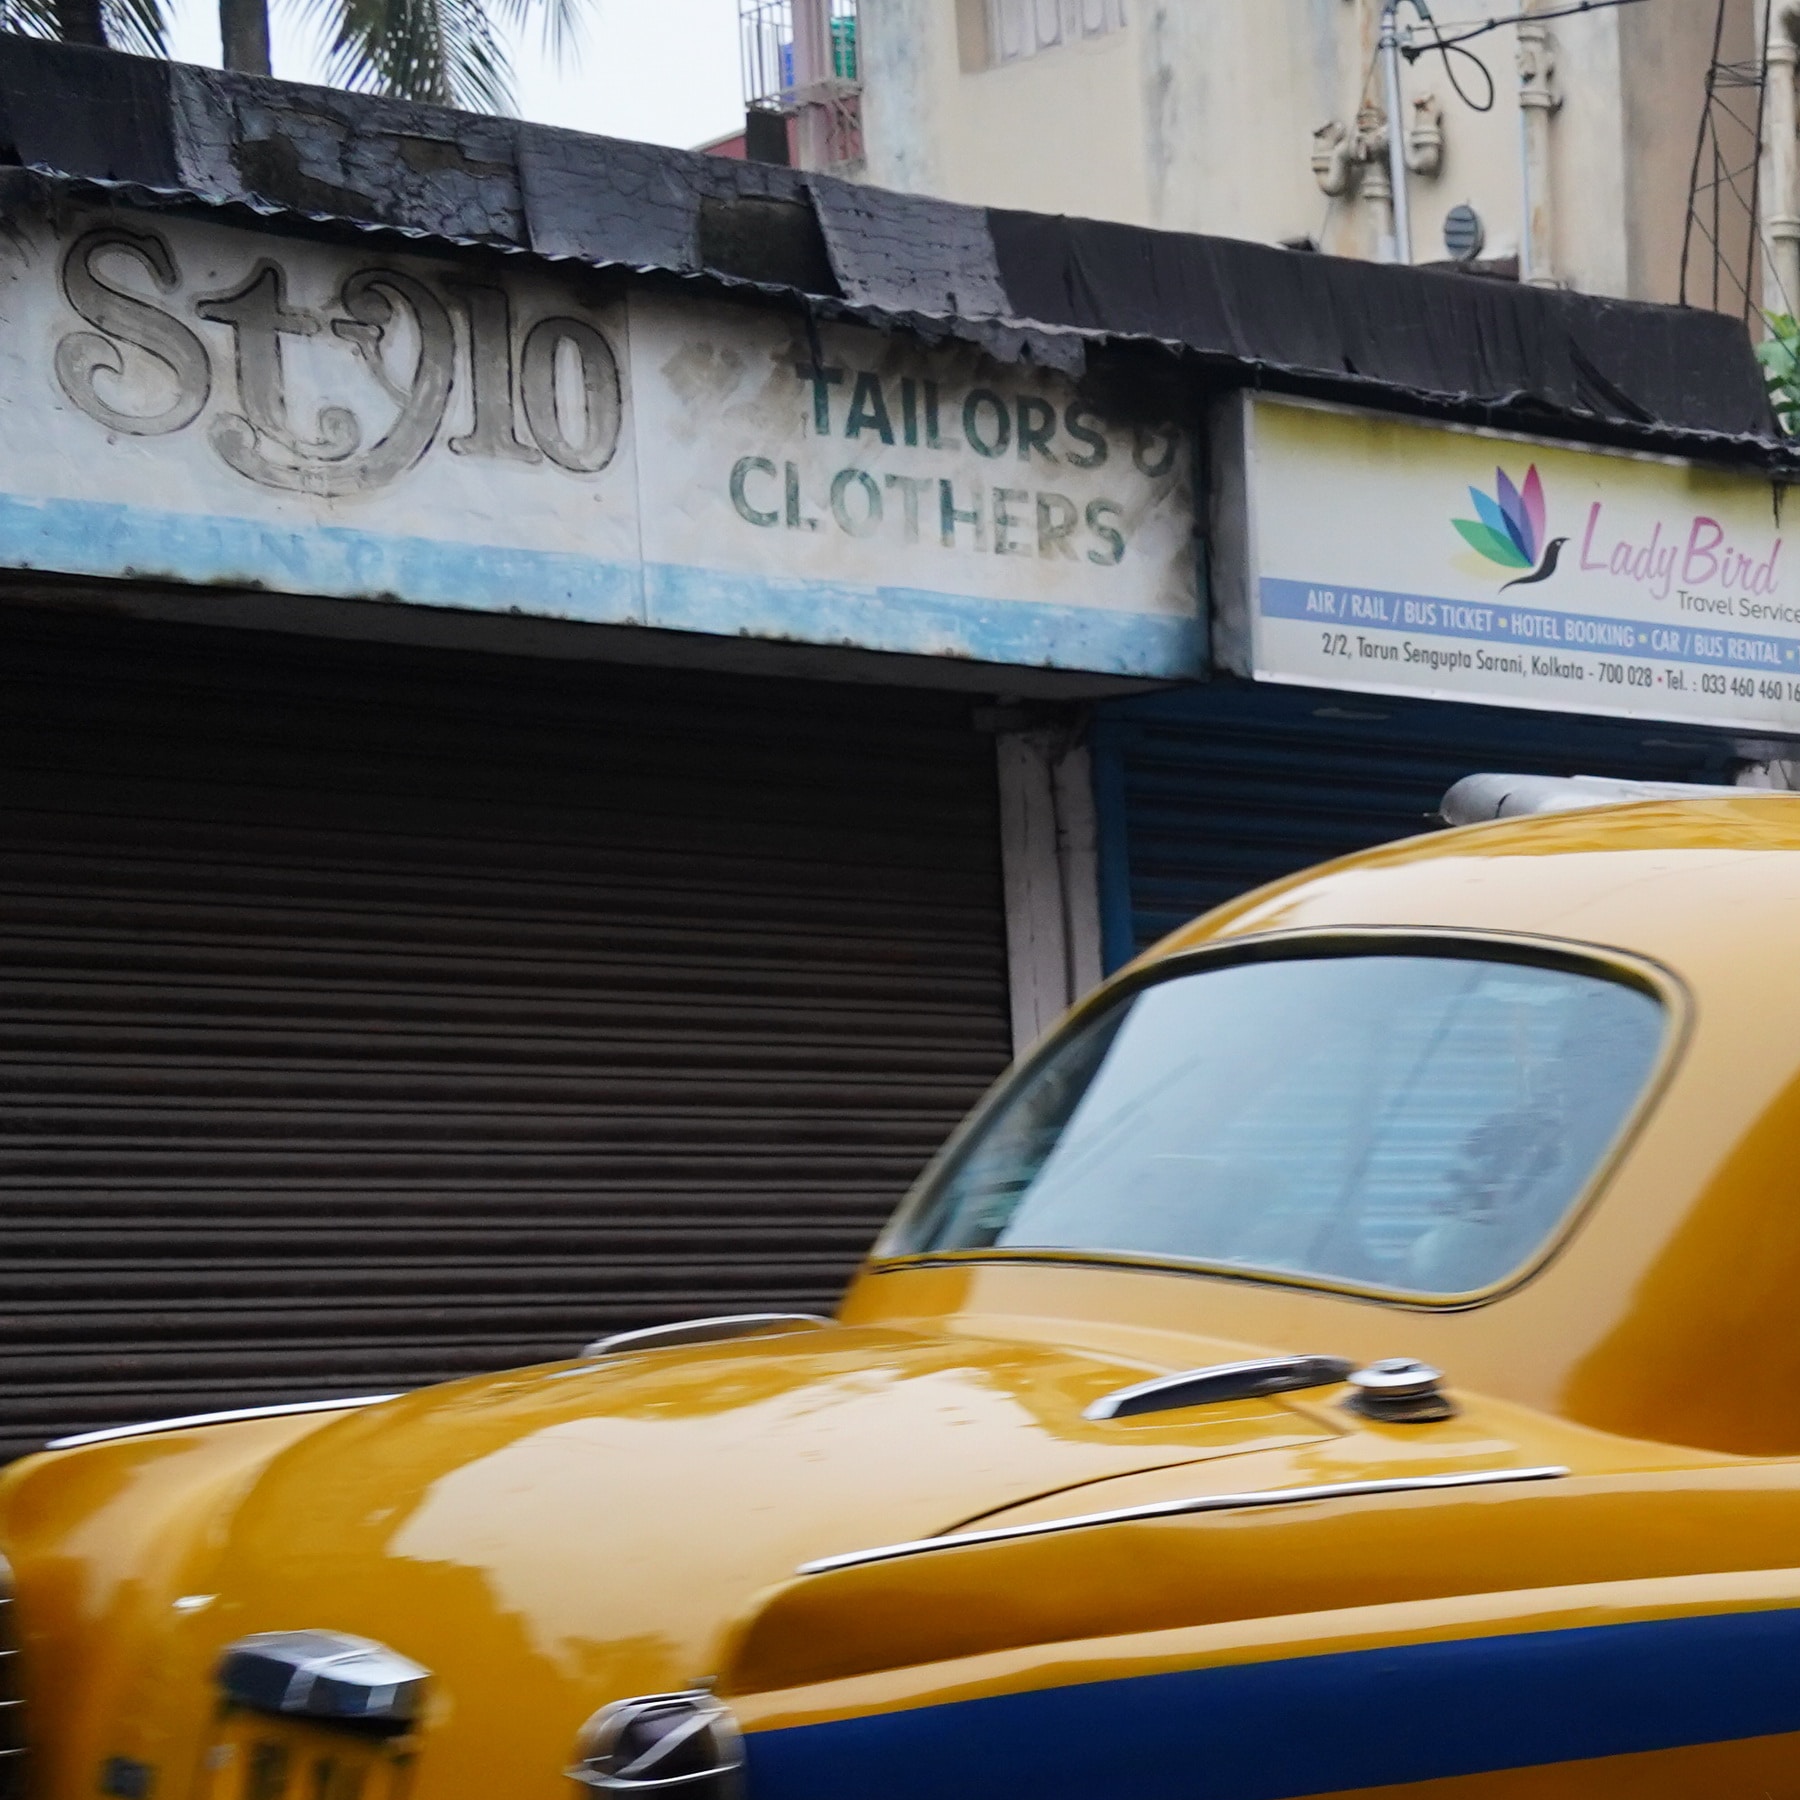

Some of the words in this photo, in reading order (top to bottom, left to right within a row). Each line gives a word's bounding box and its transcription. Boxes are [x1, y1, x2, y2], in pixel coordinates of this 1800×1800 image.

[54, 226, 623, 497] Stylo
[800, 365, 1108, 472] TAILORS
[727, 455, 1126, 568] CLOTHERS
[1306, 590, 1335, 614] AIR
[1351, 598, 1388, 622] RAIL
[1404, 602, 1436, 626] BUS
[1441, 605, 1493, 633] TICKET
[1511, 613, 1561, 641] HOTEL
[1564, 620, 1635, 648] BOOKING
[1651, 629, 1681, 652] CAR
[1694, 634, 1723, 658] BUS
[1727, 638, 1782, 665] RENTAL
[1677, 590, 1733, 616] Travel
[1356, 637, 1398, 661] Tarun
[1403, 642, 1471, 672] Sengupta
[1476, 650, 1527, 677] Sarani,
[1531, 656, 1583, 681] Kolkata
[1598, 662, 1623, 684] 700
[1627, 666, 1652, 688] 028
[1702, 673, 1726, 695] 033
[1730, 675, 1753, 697] 460
[1758, 678, 1782, 700] 460
[1787, 681, 1800, 702] 16
